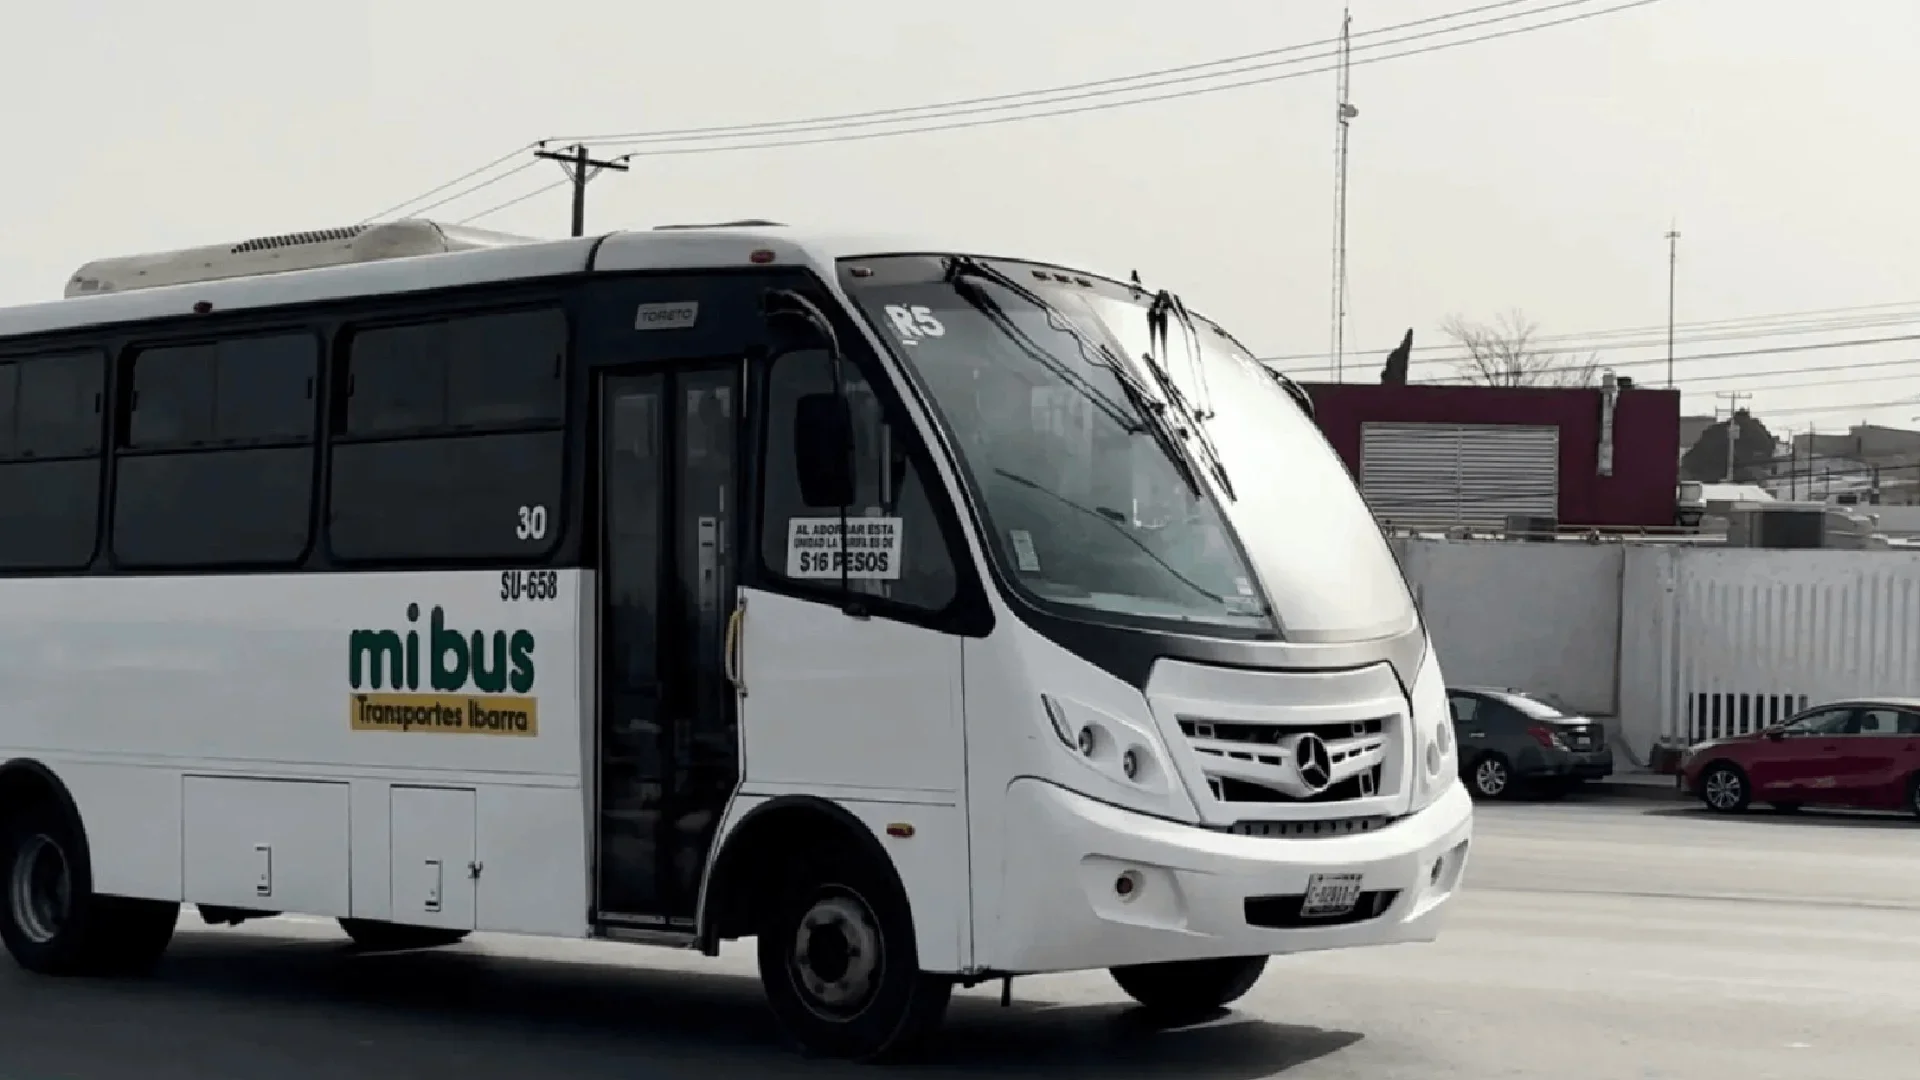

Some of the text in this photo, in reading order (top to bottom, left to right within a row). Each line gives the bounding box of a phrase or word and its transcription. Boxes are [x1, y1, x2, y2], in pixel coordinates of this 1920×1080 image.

[884, 304, 945, 336] R5
[516, 505, 547, 540] 30
[796, 525, 810, 535] AL
[868, 525, 894, 535] ESTA
[827, 538, 838, 548] LA
[833, 551, 888, 573] PESOS
[500, 570, 558, 601] SU-658
[431, 605, 535, 693] bus
[358, 694, 528, 732] Transportes Ibarra
